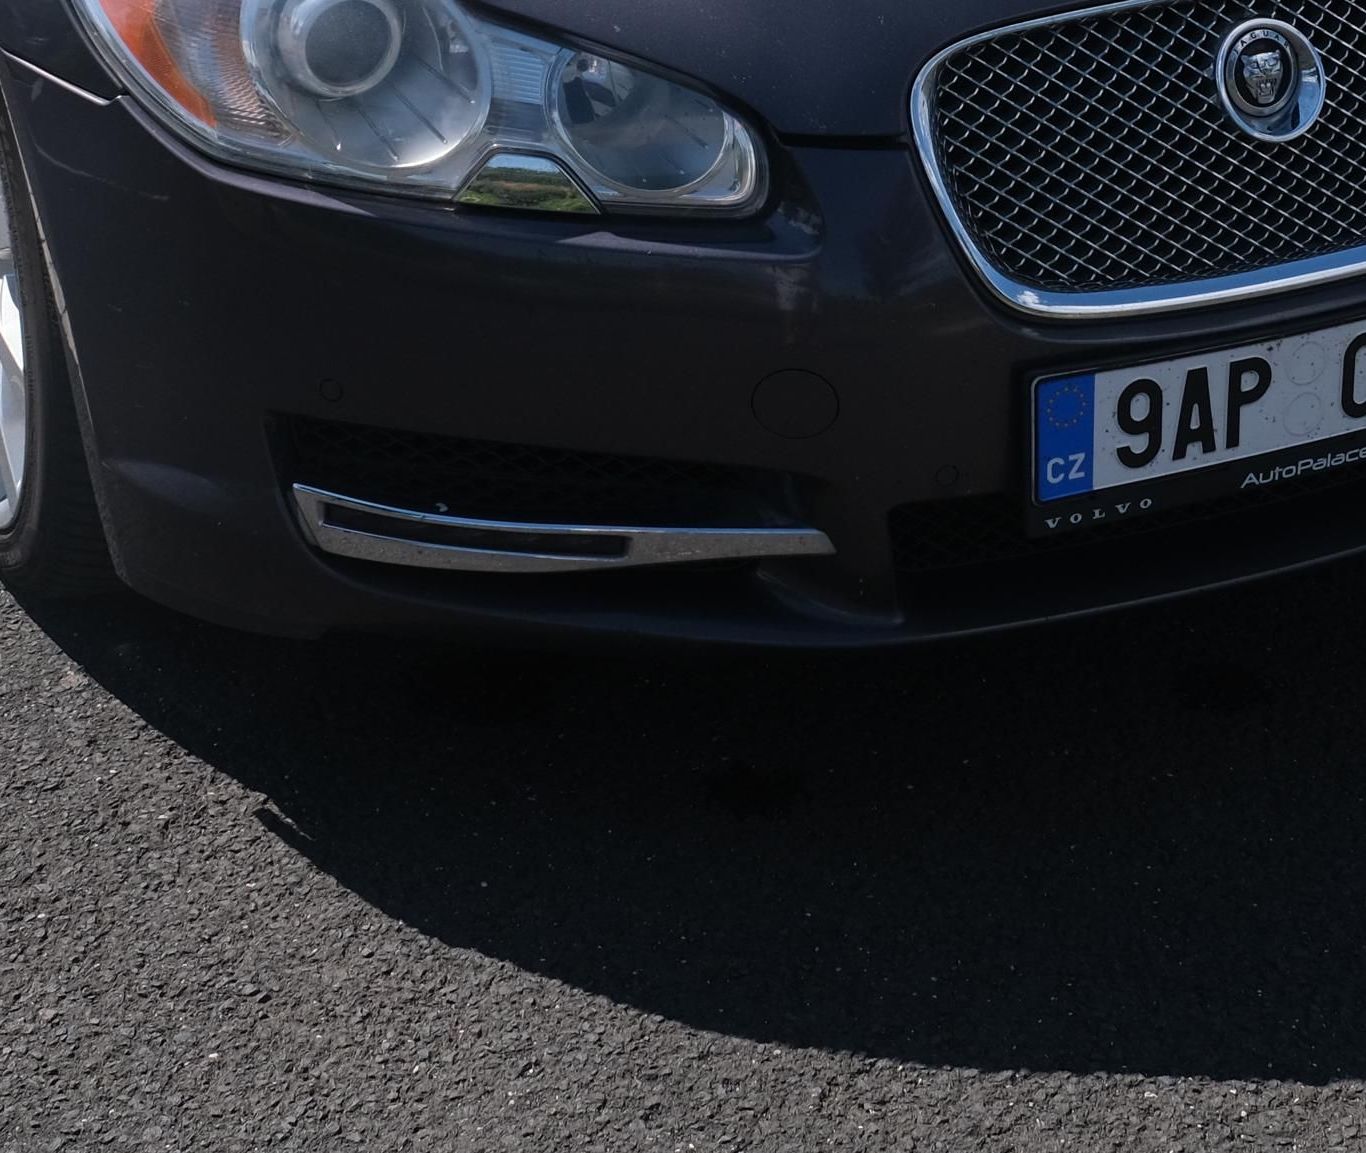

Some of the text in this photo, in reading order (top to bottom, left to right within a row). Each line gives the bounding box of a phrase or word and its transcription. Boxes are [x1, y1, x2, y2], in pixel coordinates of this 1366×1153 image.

[1234, 30, 1290, 54] JAGUAR
[1116, 356, 1272, 469] 9AP
[1046, 452, 1086, 485] CZ
[1044, 498, 1153, 529] VOLVO
